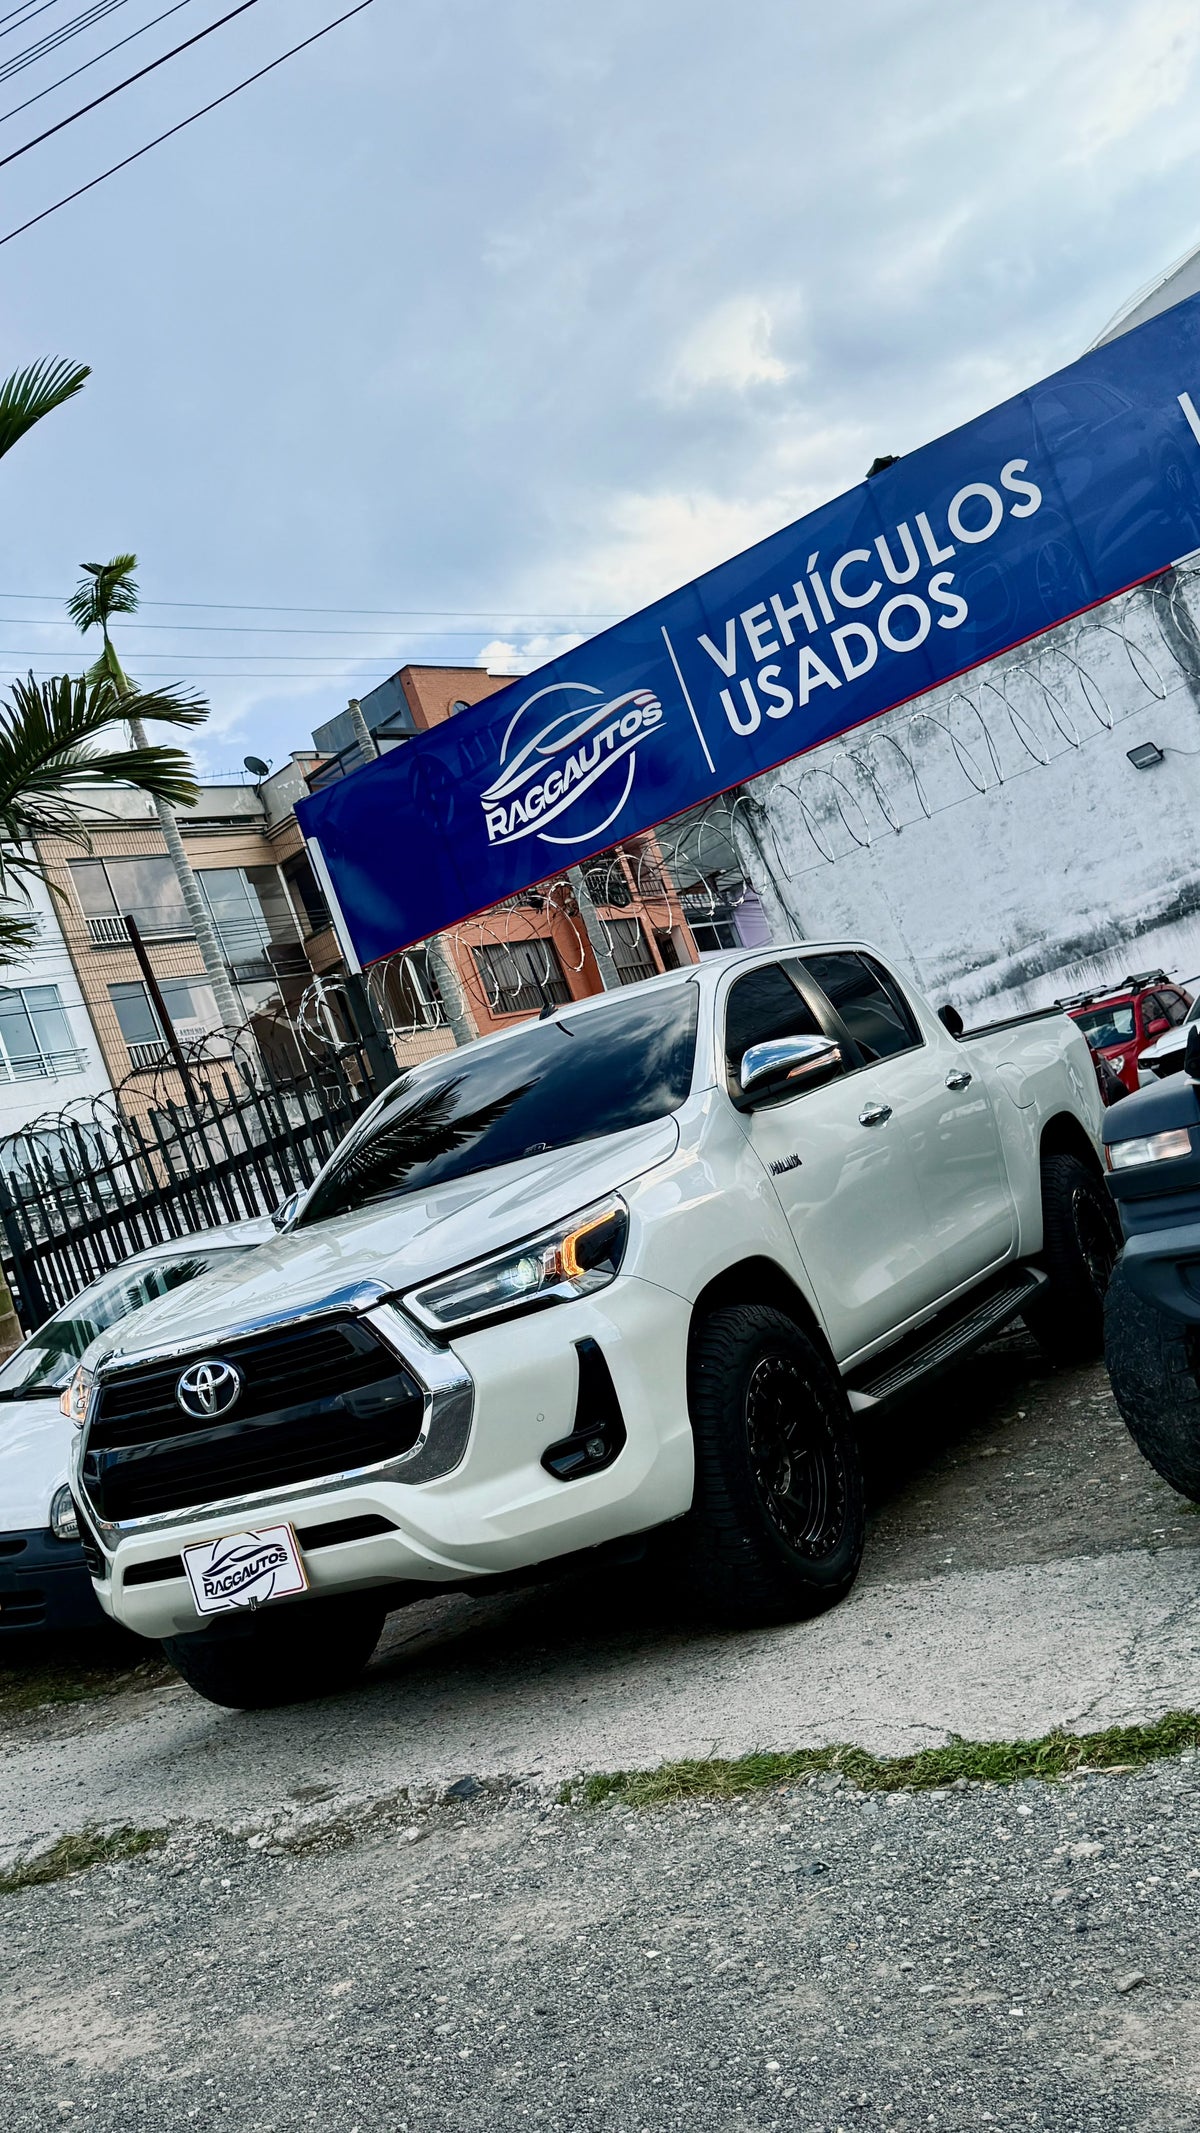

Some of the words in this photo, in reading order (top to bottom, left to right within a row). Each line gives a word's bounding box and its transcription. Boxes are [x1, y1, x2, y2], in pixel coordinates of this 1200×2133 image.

[698, 459, 1042, 678] VEHÍCULOS
[720, 572, 968, 737] USADOS
[485, 701, 663, 841] RAGGAUTOS
[203, 1552, 288, 1597] RAGGAUTOS
